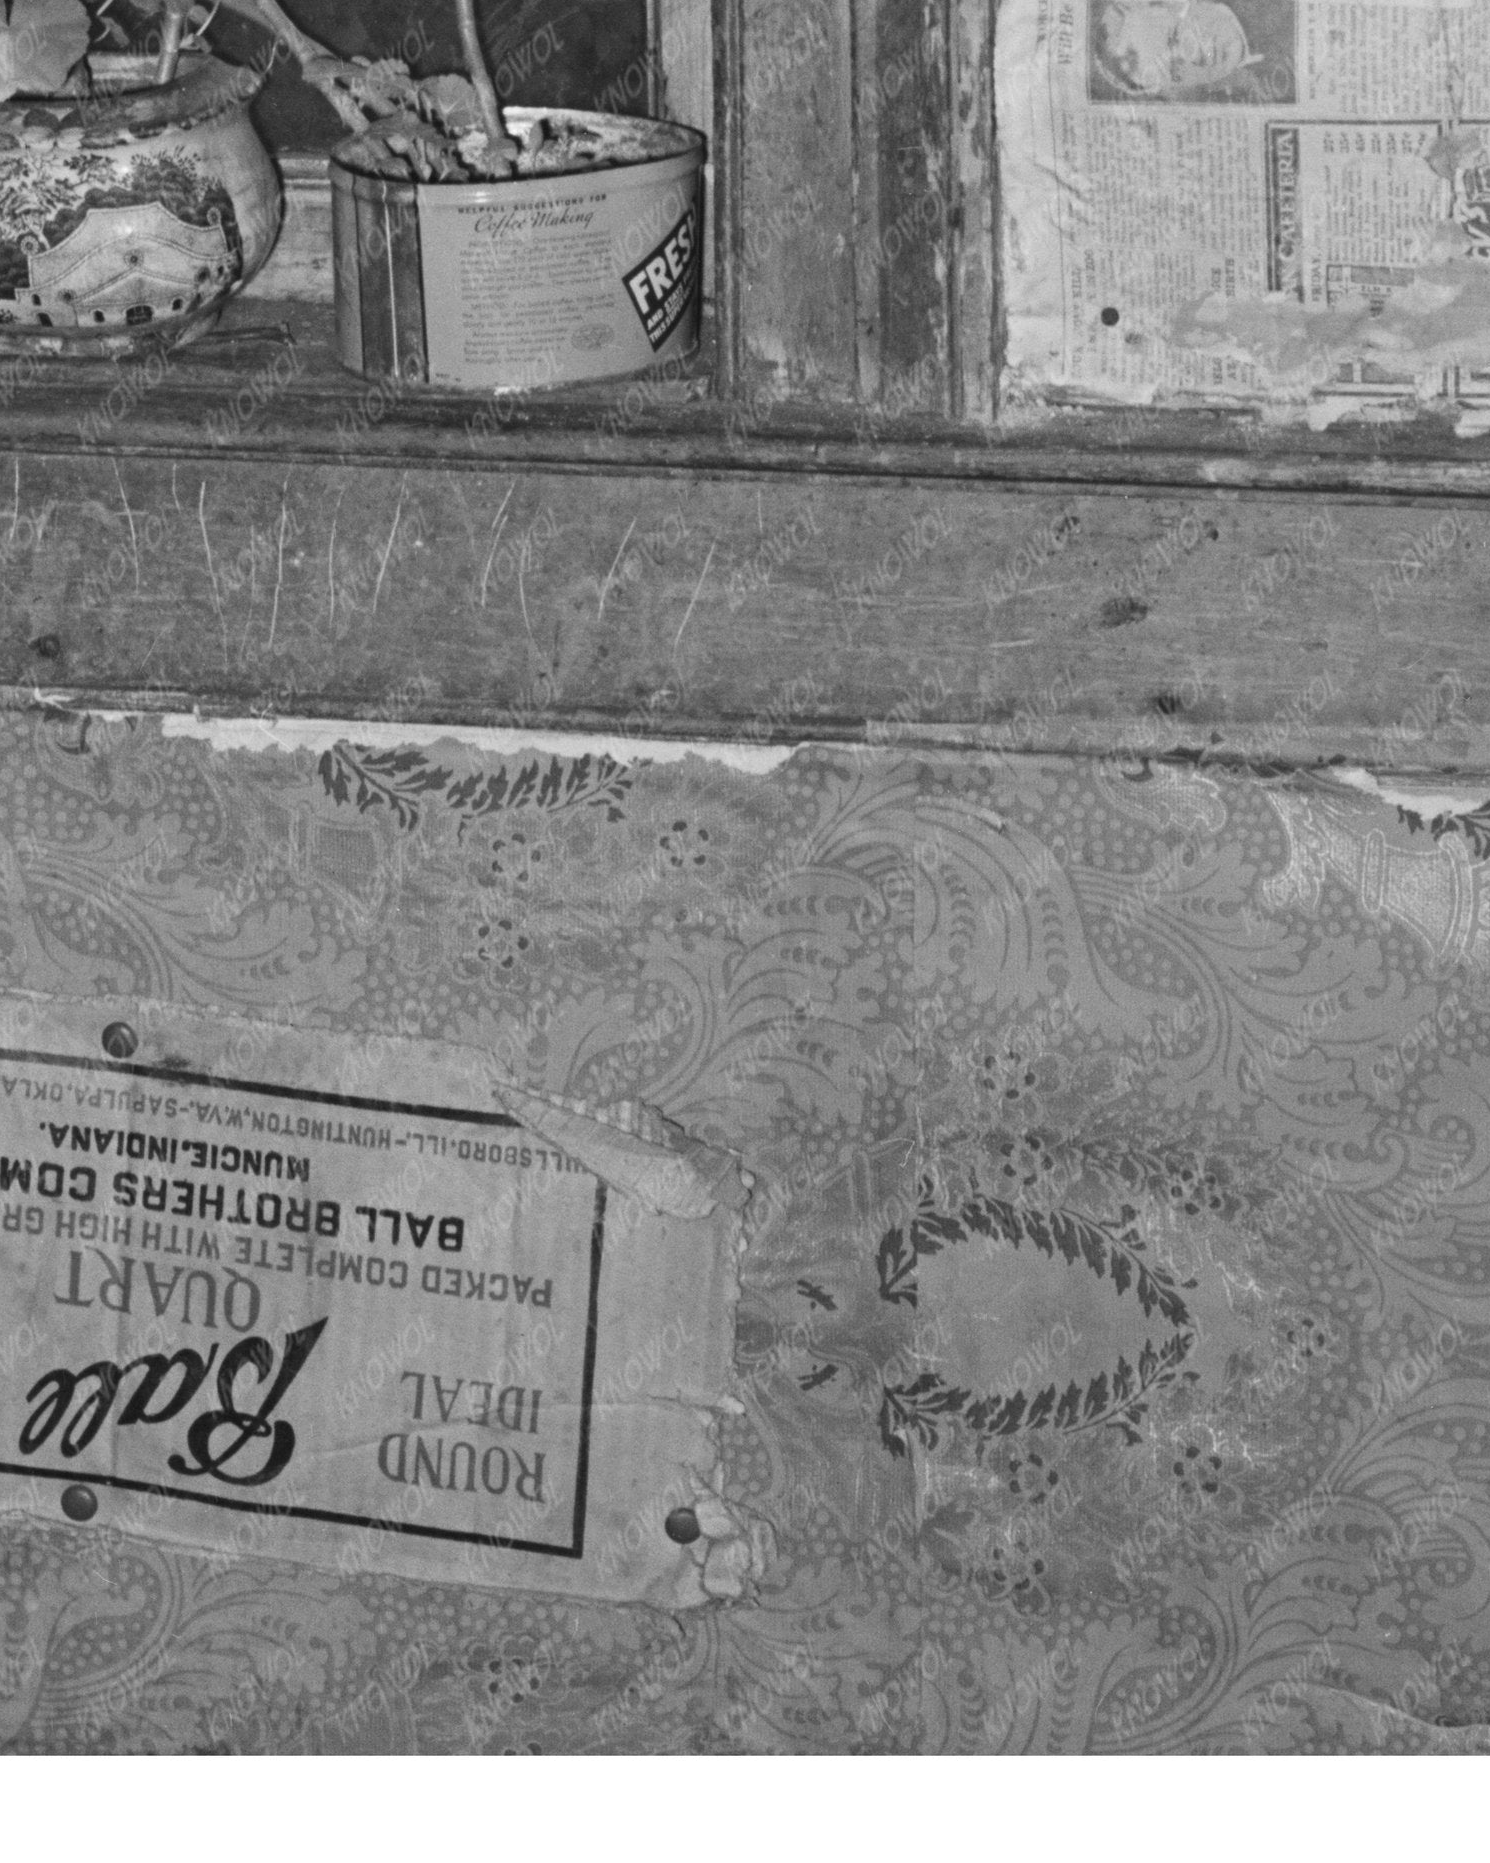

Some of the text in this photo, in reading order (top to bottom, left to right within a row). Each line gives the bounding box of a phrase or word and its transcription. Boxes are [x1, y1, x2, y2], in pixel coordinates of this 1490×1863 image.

[473, 206, 595, 239] Coffee Making
[1278, 131, 1296, 261] CAFETERIA
[54, 1208, 132, 1247] HIGH
[111, 1170, 341, 1239] BROTHERS
[354, 1204, 466, 1253] BALL
[141, 1220, 220, 1262] WITH
[234, 1233, 409, 1290] COMPLETE
[52, 1245, 262, 1334] QUART
[420, 1263, 553, 1310] PACKED
[18, 1316, 329, 1487] Ball
[399, 1370, 544, 1434] IDEAL
[377, 1432, 547, 1503] ROUND
